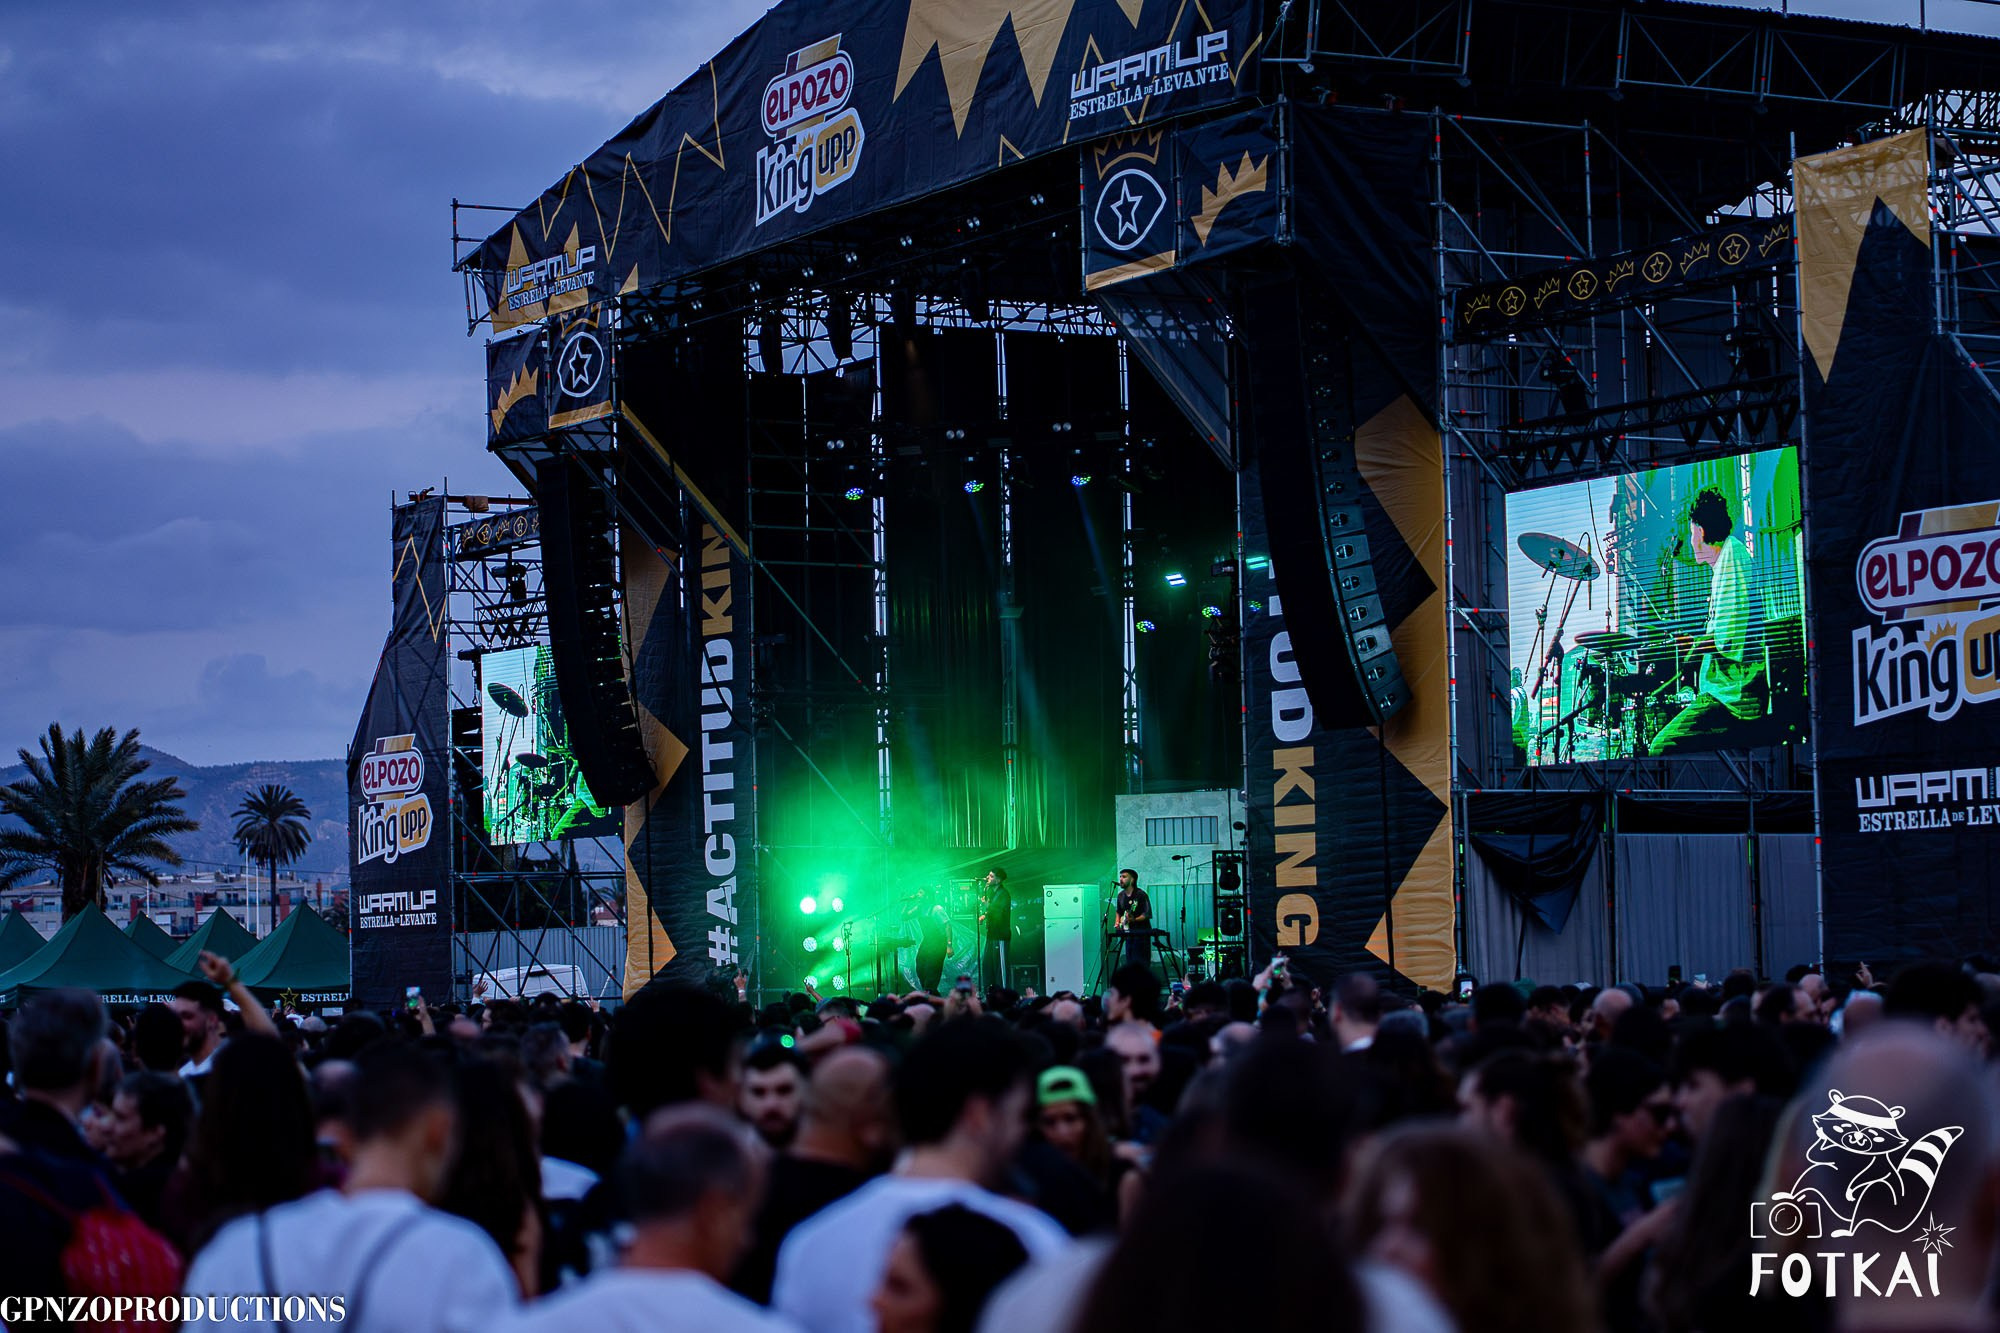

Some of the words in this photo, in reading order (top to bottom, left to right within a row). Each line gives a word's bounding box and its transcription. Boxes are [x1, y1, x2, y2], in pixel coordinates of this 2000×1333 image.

[1069, 84, 1143, 120] ESTRELLA
[1144, 84, 1153, 95] DE
[1153, 62, 1229, 96] LEVANTE
[508, 285, 548, 310] ESTRELLA
[554, 271, 595, 295] LEVANTE
[1858, 808, 1952, 832] ESTRELLA
[1952, 812, 1965, 821] DE
[360, 915, 395, 929] ESTRELLA
[400, 912, 437, 926] LEVANTE
